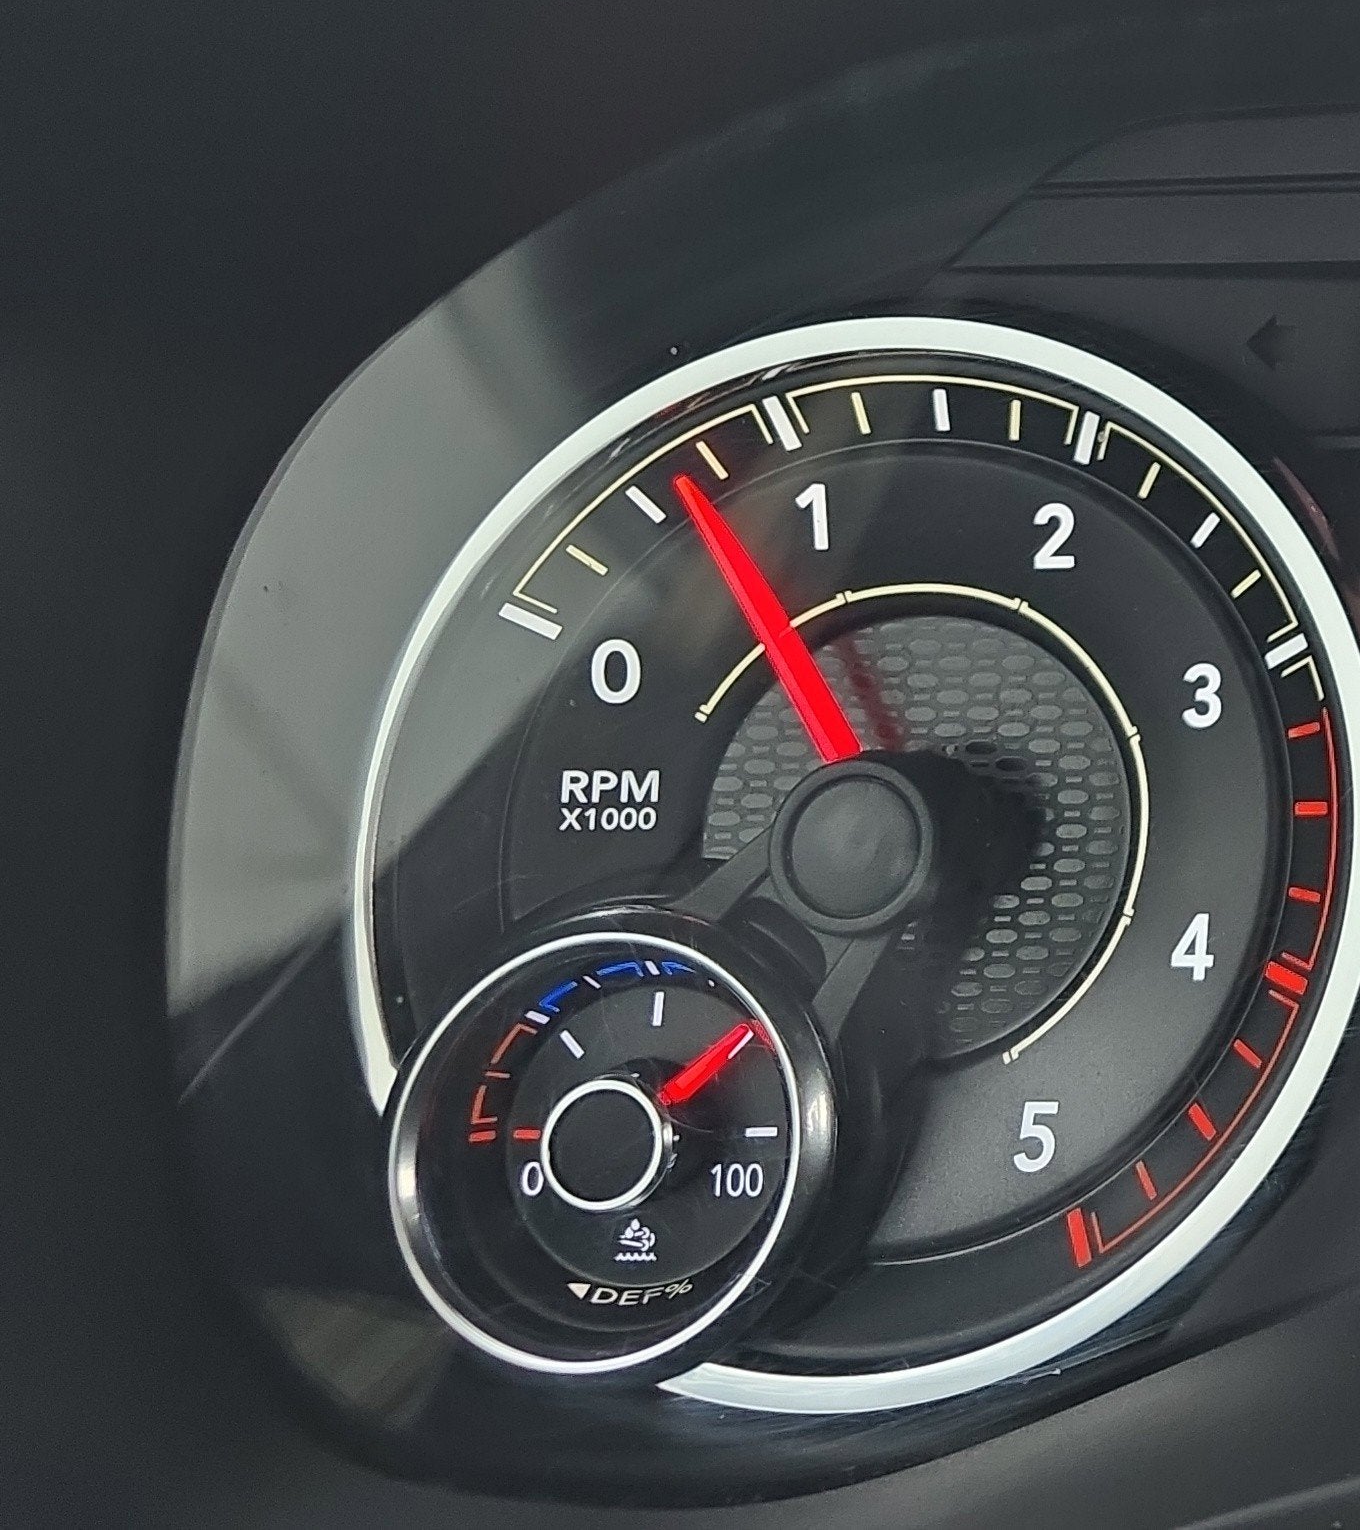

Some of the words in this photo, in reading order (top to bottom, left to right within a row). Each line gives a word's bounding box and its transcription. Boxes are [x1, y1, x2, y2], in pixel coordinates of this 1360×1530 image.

[795, 482, 830, 552] 1
[1032, 502, 1076, 570] 2
[590, 639, 642, 704] 0
[1181, 662, 1224, 729] 3
[558, 807, 658, 832] X1000
[559, 770, 661, 804] RPM
[1171, 913, 1215, 982] 4
[1013, 1101, 1060, 1173] 5
[521, 1161, 545, 1196] 0
[711, 1163, 765, 1197] 100
